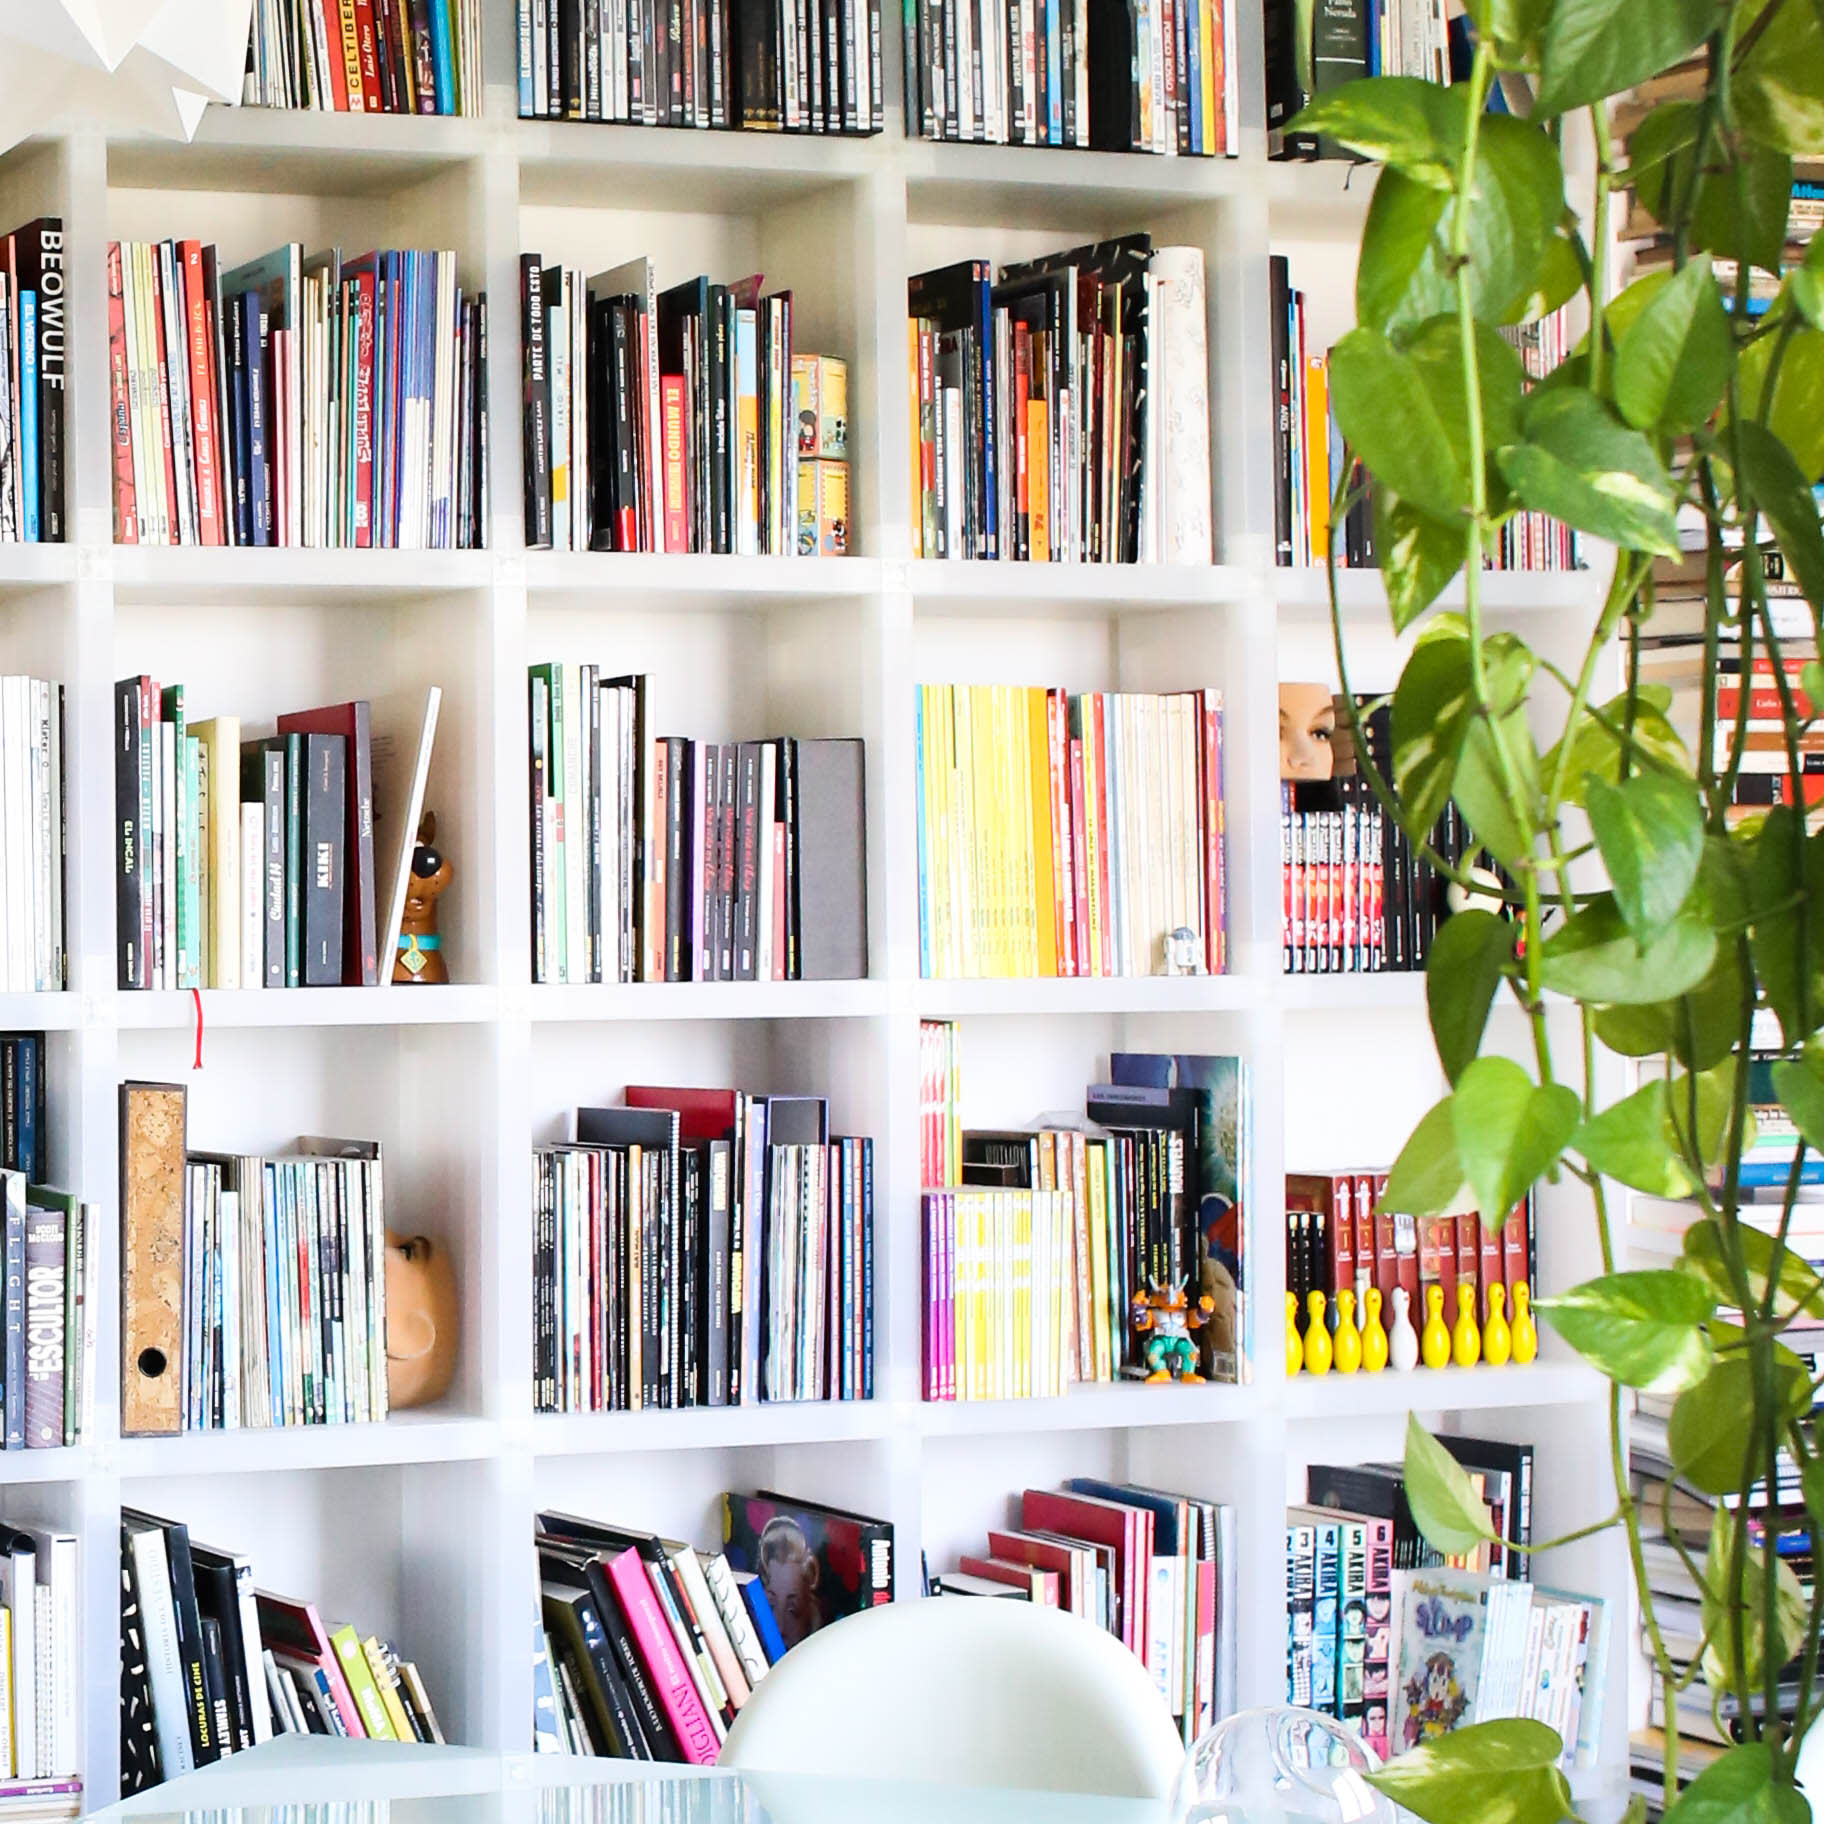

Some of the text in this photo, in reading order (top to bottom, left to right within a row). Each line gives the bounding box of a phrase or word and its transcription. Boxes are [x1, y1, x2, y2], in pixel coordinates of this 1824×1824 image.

[359, 24, 374, 53] Otero
[1324, 6, 1357, 20] Neruda
[362, 54, 375, 78] Luis
[1162, 20, 1174, 91] PORCO ROSSO
[24, 303, 35, 364] EL VECINO
[39, 229, 65, 391] BEOWULF
[528, 266, 545, 381] PARTE DE TODO ESTO
[115, 401, 130, 447] España
[666, 387, 681, 460] EL MUNDO
[124, 820, 135, 874] EL INCAL
[360, 797, 372, 838] Nietzsche
[317, 841, 330, 888] KIKI
[268, 877, 283, 921] Ciudad
[1169, 1137, 1184, 1194] MARVELS
[8, 1216, 22, 1334] FLIGHT
[27, 1265, 64, 1372] ESCULTOR
[1295, 1528, 1314, 1600] 3 AKIRA
[1319, 1531, 1338, 1595] 4 AKIRA
[1346, 1531, 1365, 1597] 5 AKIRA
[1371, 1525, 1390, 1592] 6 AKIRA
[1415, 1598, 1474, 1643] SLUMP
[191, 1661, 210, 1748] LOCURAS DE CINE
[214, 1698, 232, 1746] STANLEY
